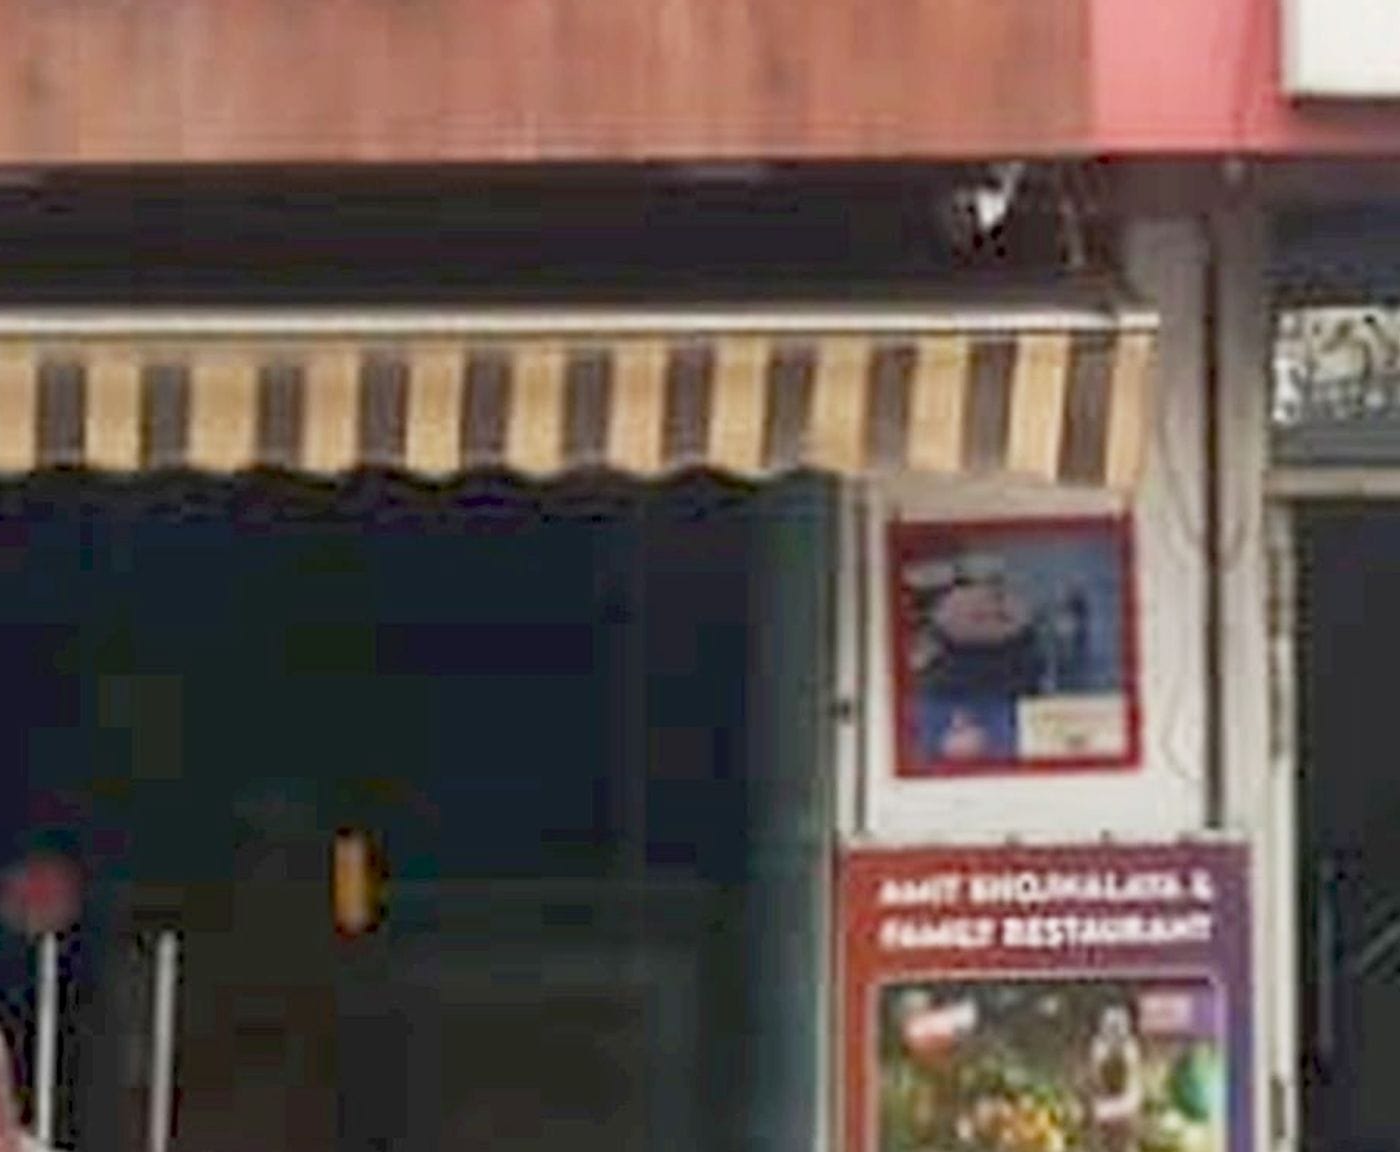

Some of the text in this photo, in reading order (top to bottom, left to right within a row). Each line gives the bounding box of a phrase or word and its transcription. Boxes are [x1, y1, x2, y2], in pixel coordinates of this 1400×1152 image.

[879, 871, 961, 906] AMIT
[879, 911, 1213, 950] FAMILY RESTAURANT
